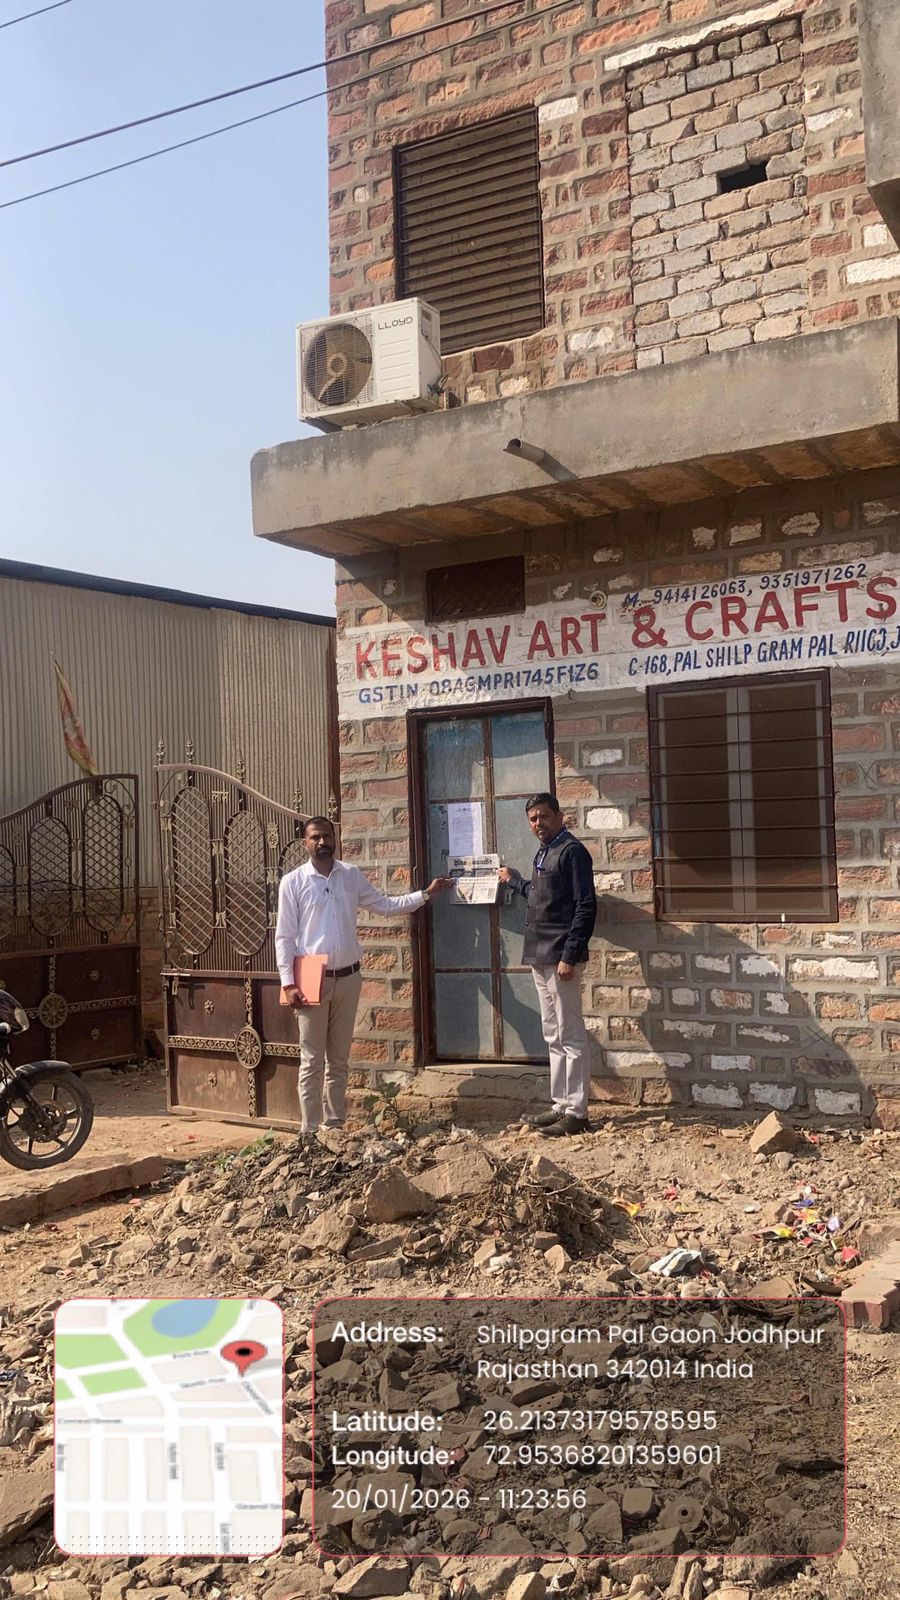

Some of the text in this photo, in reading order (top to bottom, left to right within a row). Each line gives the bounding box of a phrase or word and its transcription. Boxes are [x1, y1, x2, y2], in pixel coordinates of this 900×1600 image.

[378, 316, 413, 329] LLOYD
[653, 579, 753, 605] 9414126063,
[761, 563, 866, 590] 9351971262
[355, 576, 897, 680] KESHAV ART & CRAFTS
[706, 644, 752, 669] SHILP
[757, 637, 803, 663] GRAM
[808, 633, 838, 658] PAL
[358, 682, 418, 704] GSTIN
